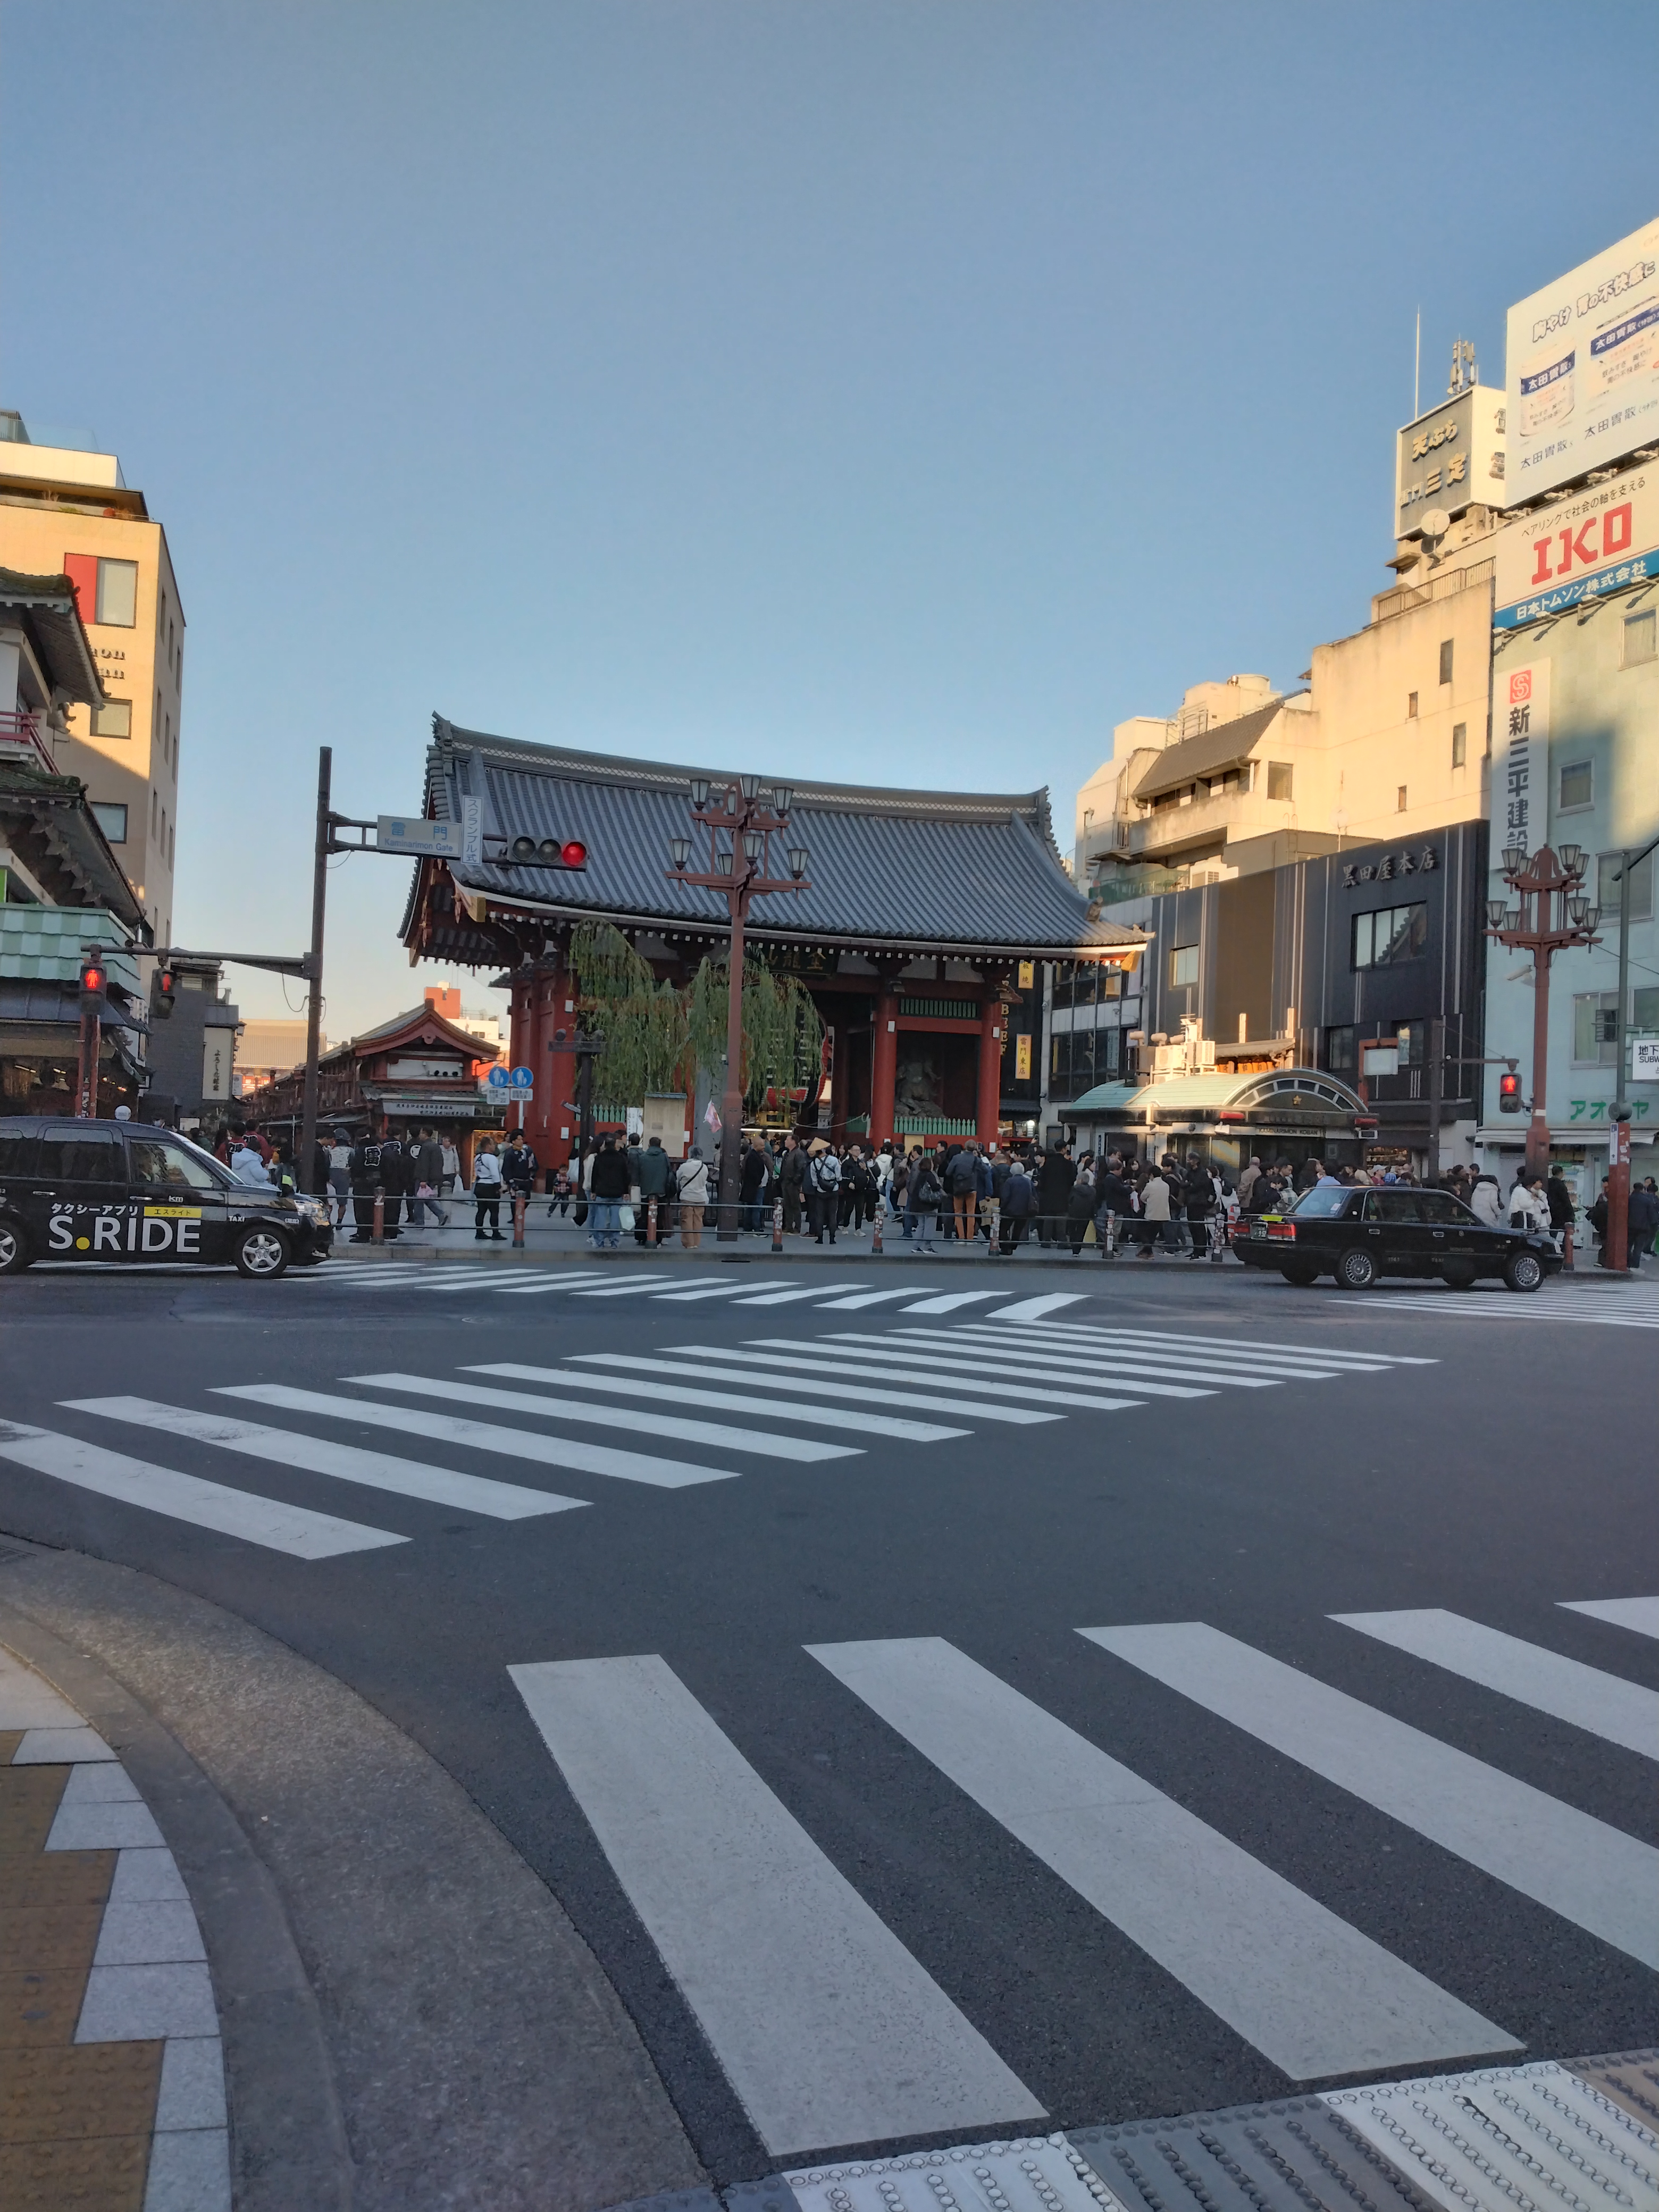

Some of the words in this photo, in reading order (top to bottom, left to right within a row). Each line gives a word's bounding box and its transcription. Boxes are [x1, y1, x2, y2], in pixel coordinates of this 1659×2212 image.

[1532, 306, 1571, 343] 胸やけ
[1577, 261, 1655, 317] 胃の不快感に
[1412, 419, 1459, 462] 天ぷら
[1521, 476, 1646, 537] ベアリングで社会の軸を支える
[1532, 501, 1632, 585] IKO
[1516, 560, 1647, 621] 日本トムソン株式会社
[384, 838, 433, 850] Kaminarimon
[436, 843, 453, 851] Gate
[466, 799, 479, 862] スクランブル式
[1342, 845, 1435, 889] 黒田屋本店
[1570, 1100, 1649, 1120] アオヤ
[51, 1203, 138, 1217] タクシーアプリ
[48, 1214, 202, 1253] S.RIDE
